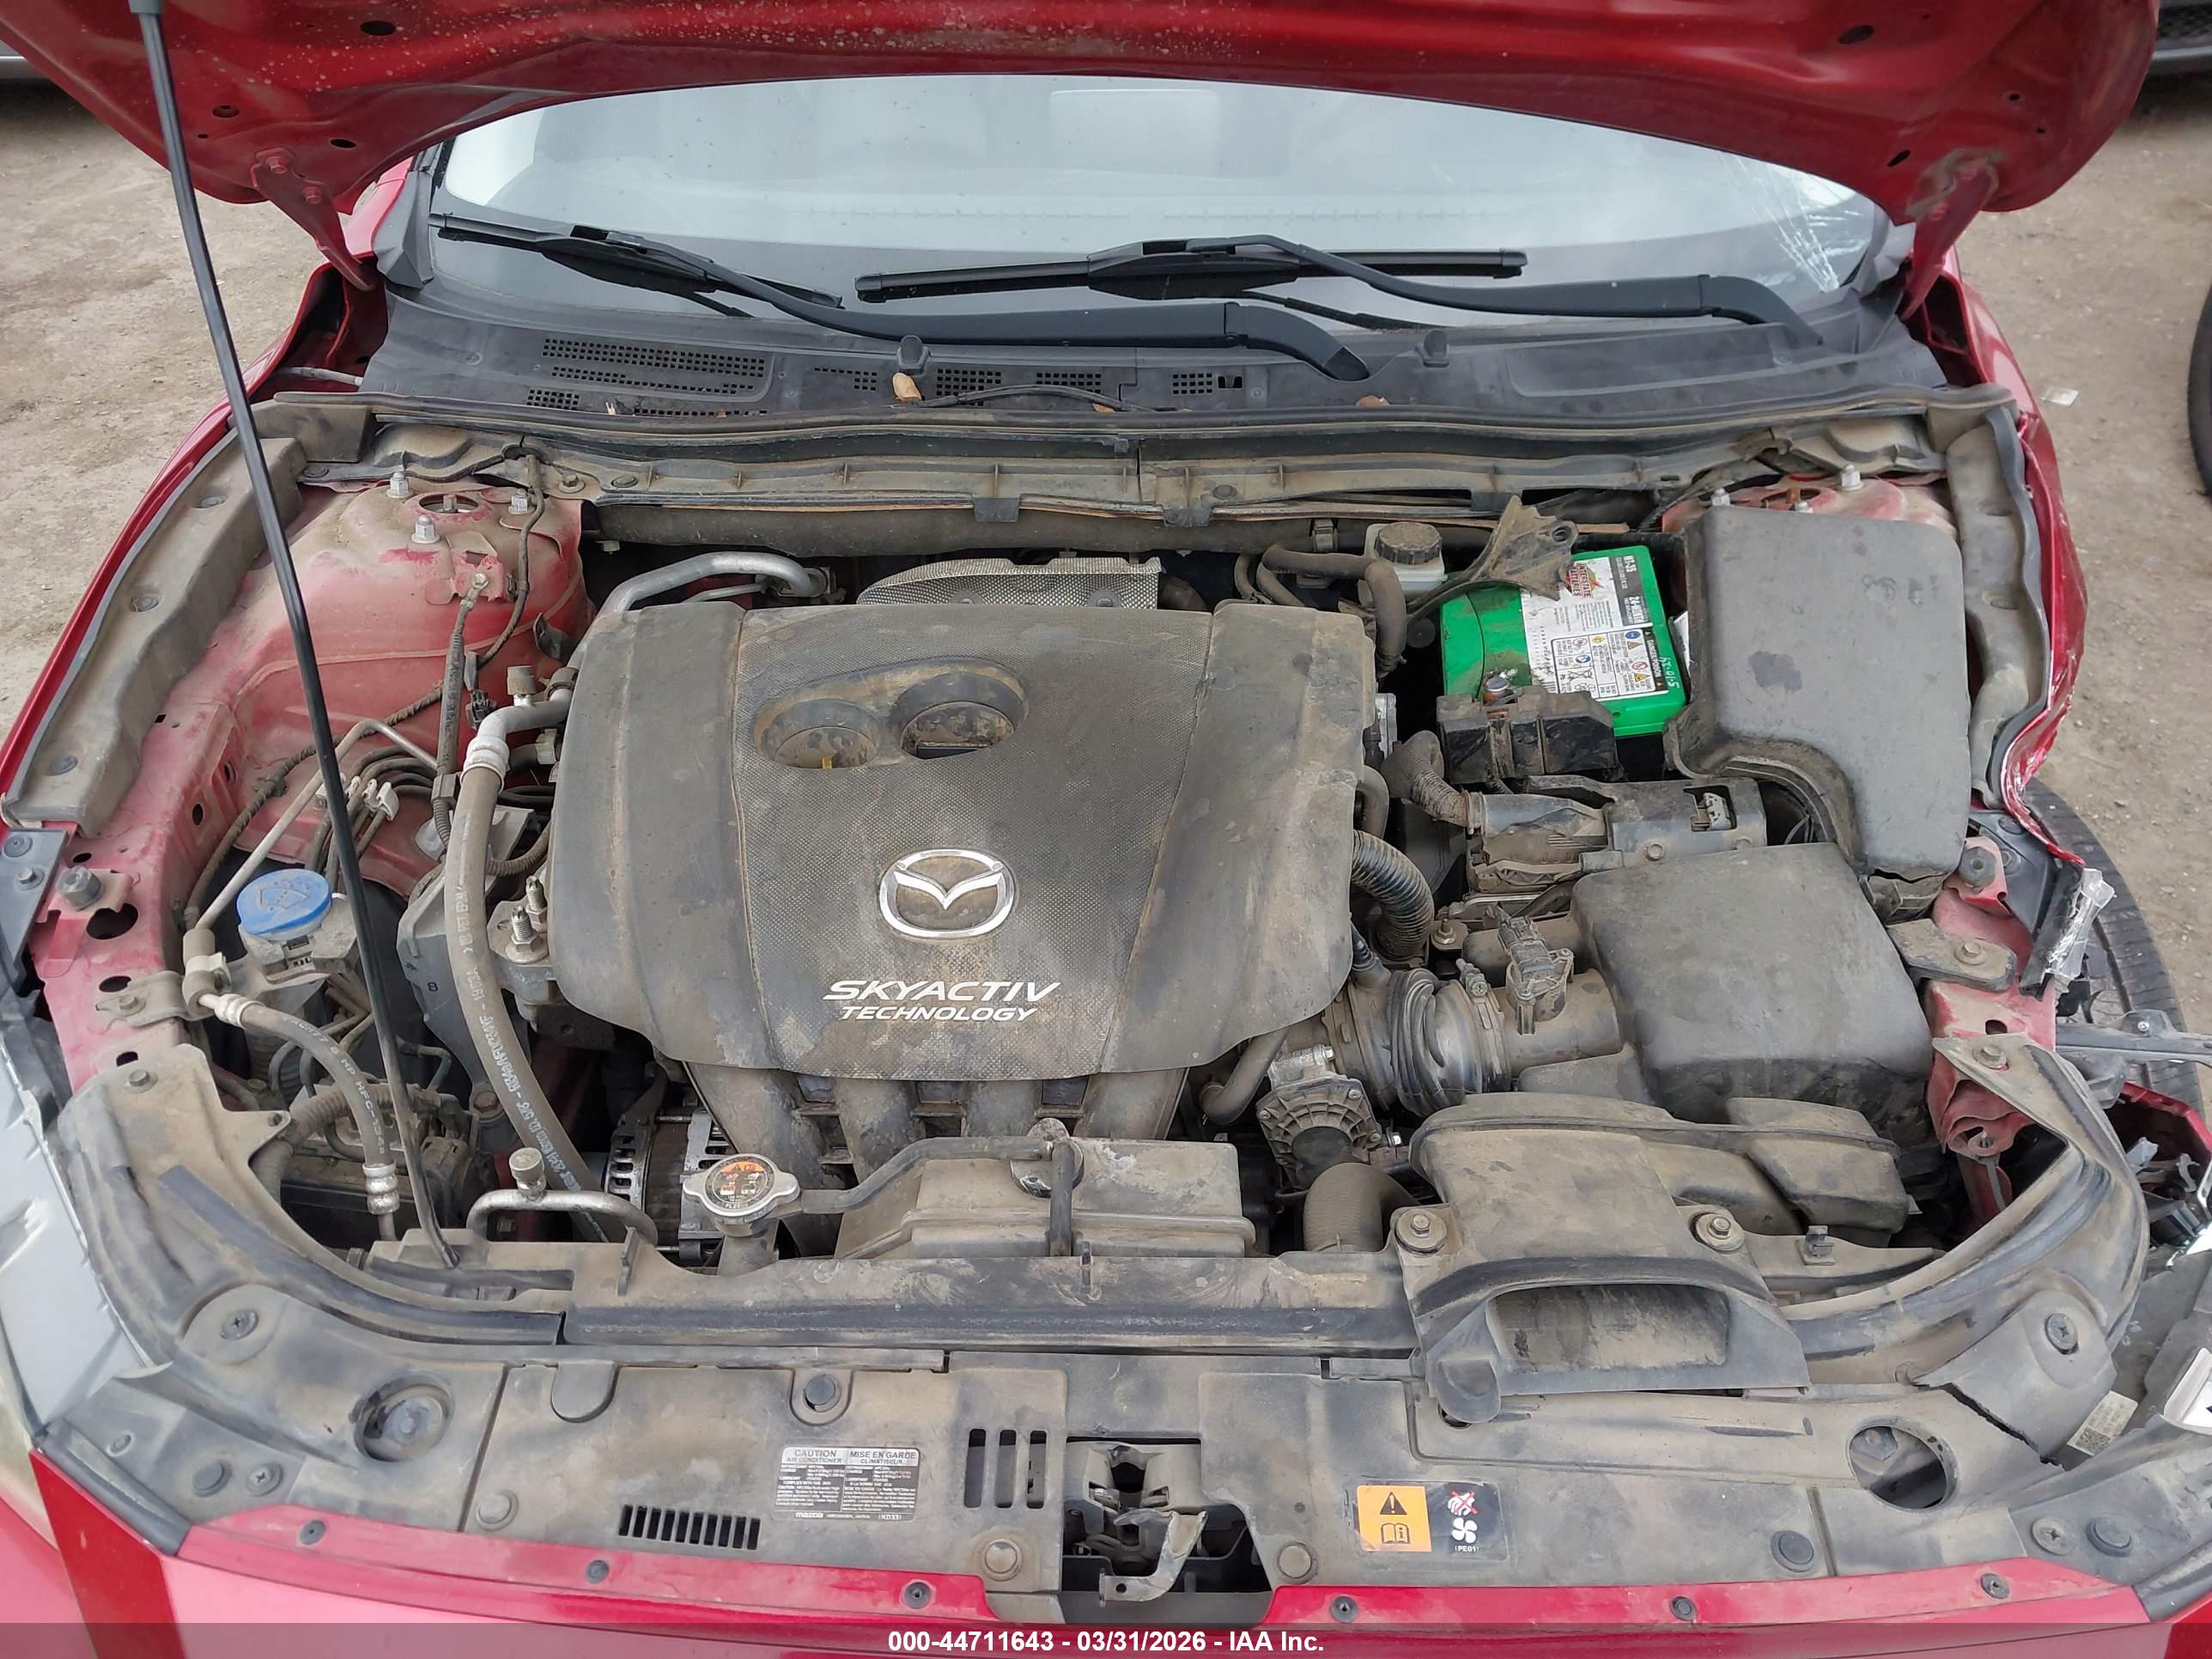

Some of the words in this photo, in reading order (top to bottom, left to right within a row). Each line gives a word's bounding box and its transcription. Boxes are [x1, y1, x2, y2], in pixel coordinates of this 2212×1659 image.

[1579, 562, 1592, 598] INTERSTATE
[822, 980, 1061, 1002] SKYACTIV
[841, 1006, 1038, 1022] TECHNOLOGY
